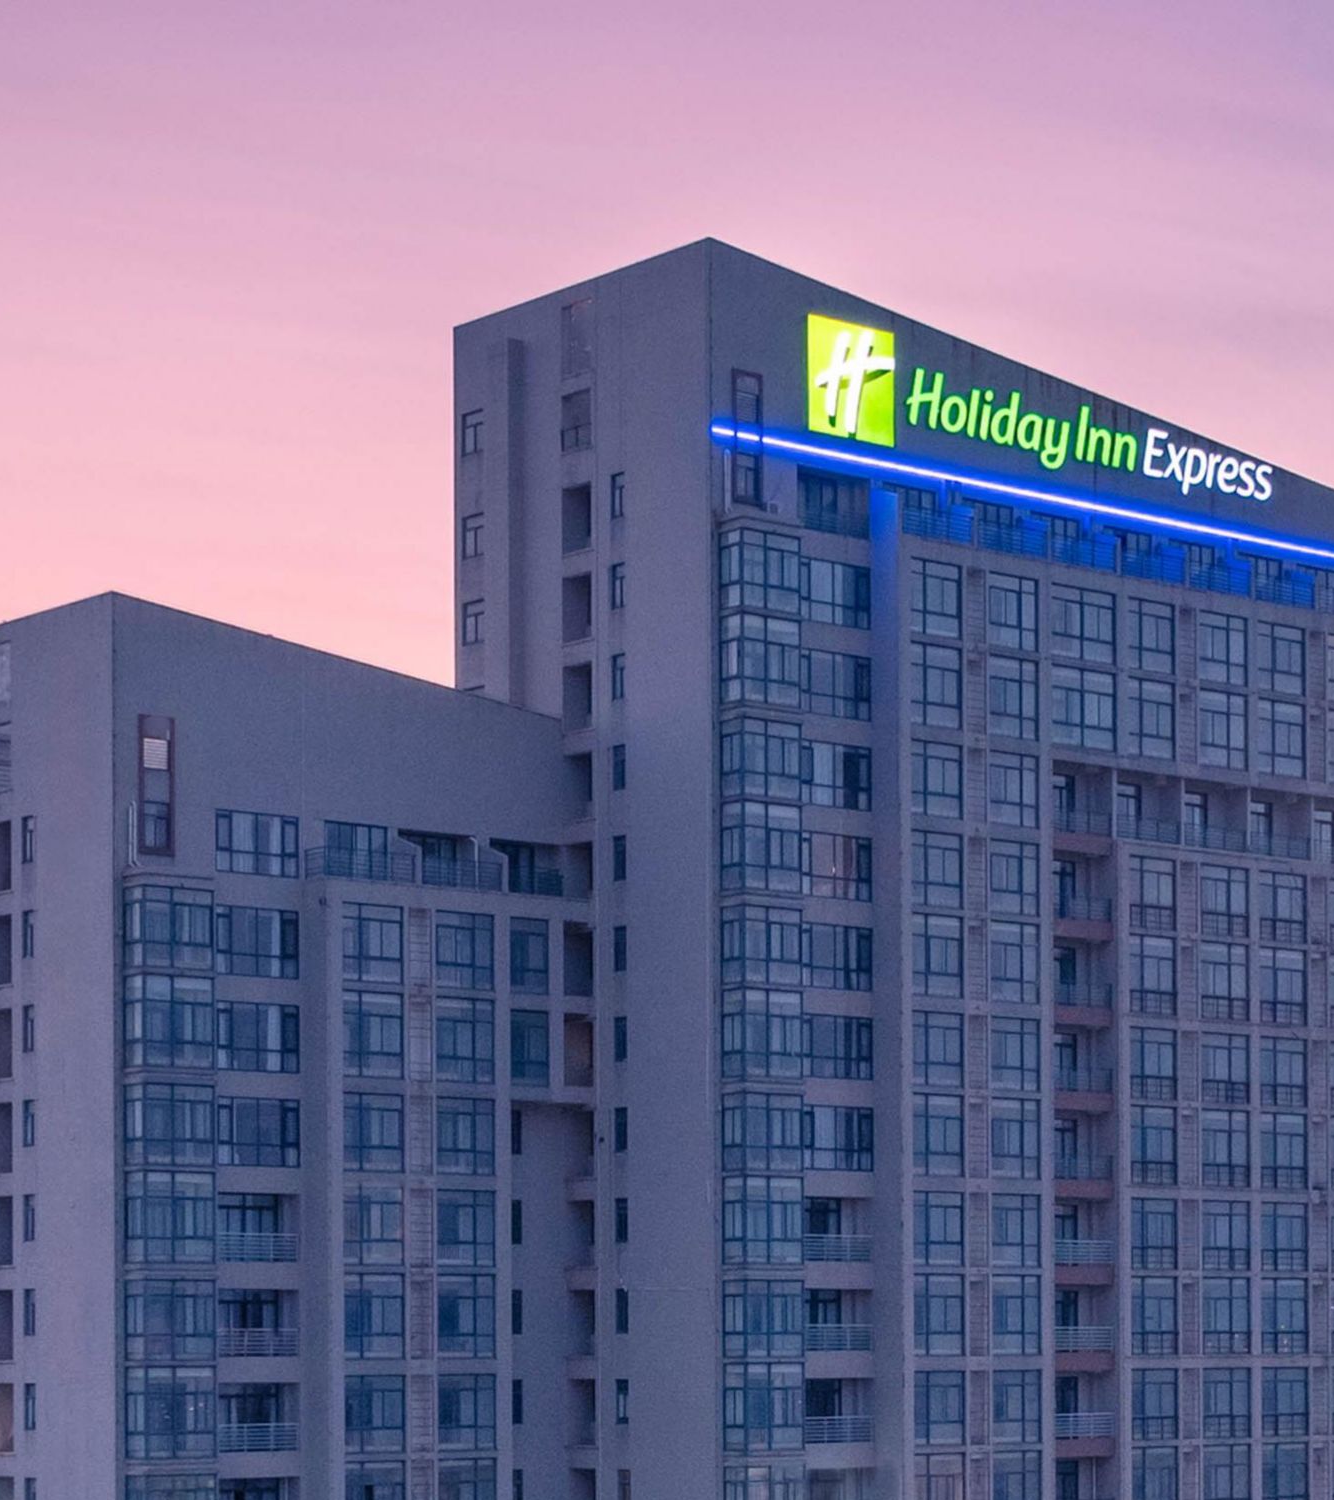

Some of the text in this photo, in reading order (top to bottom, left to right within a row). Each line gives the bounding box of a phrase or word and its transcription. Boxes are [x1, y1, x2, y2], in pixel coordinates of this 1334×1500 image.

[906, 367, 1274, 501] Holiday Inn Express
